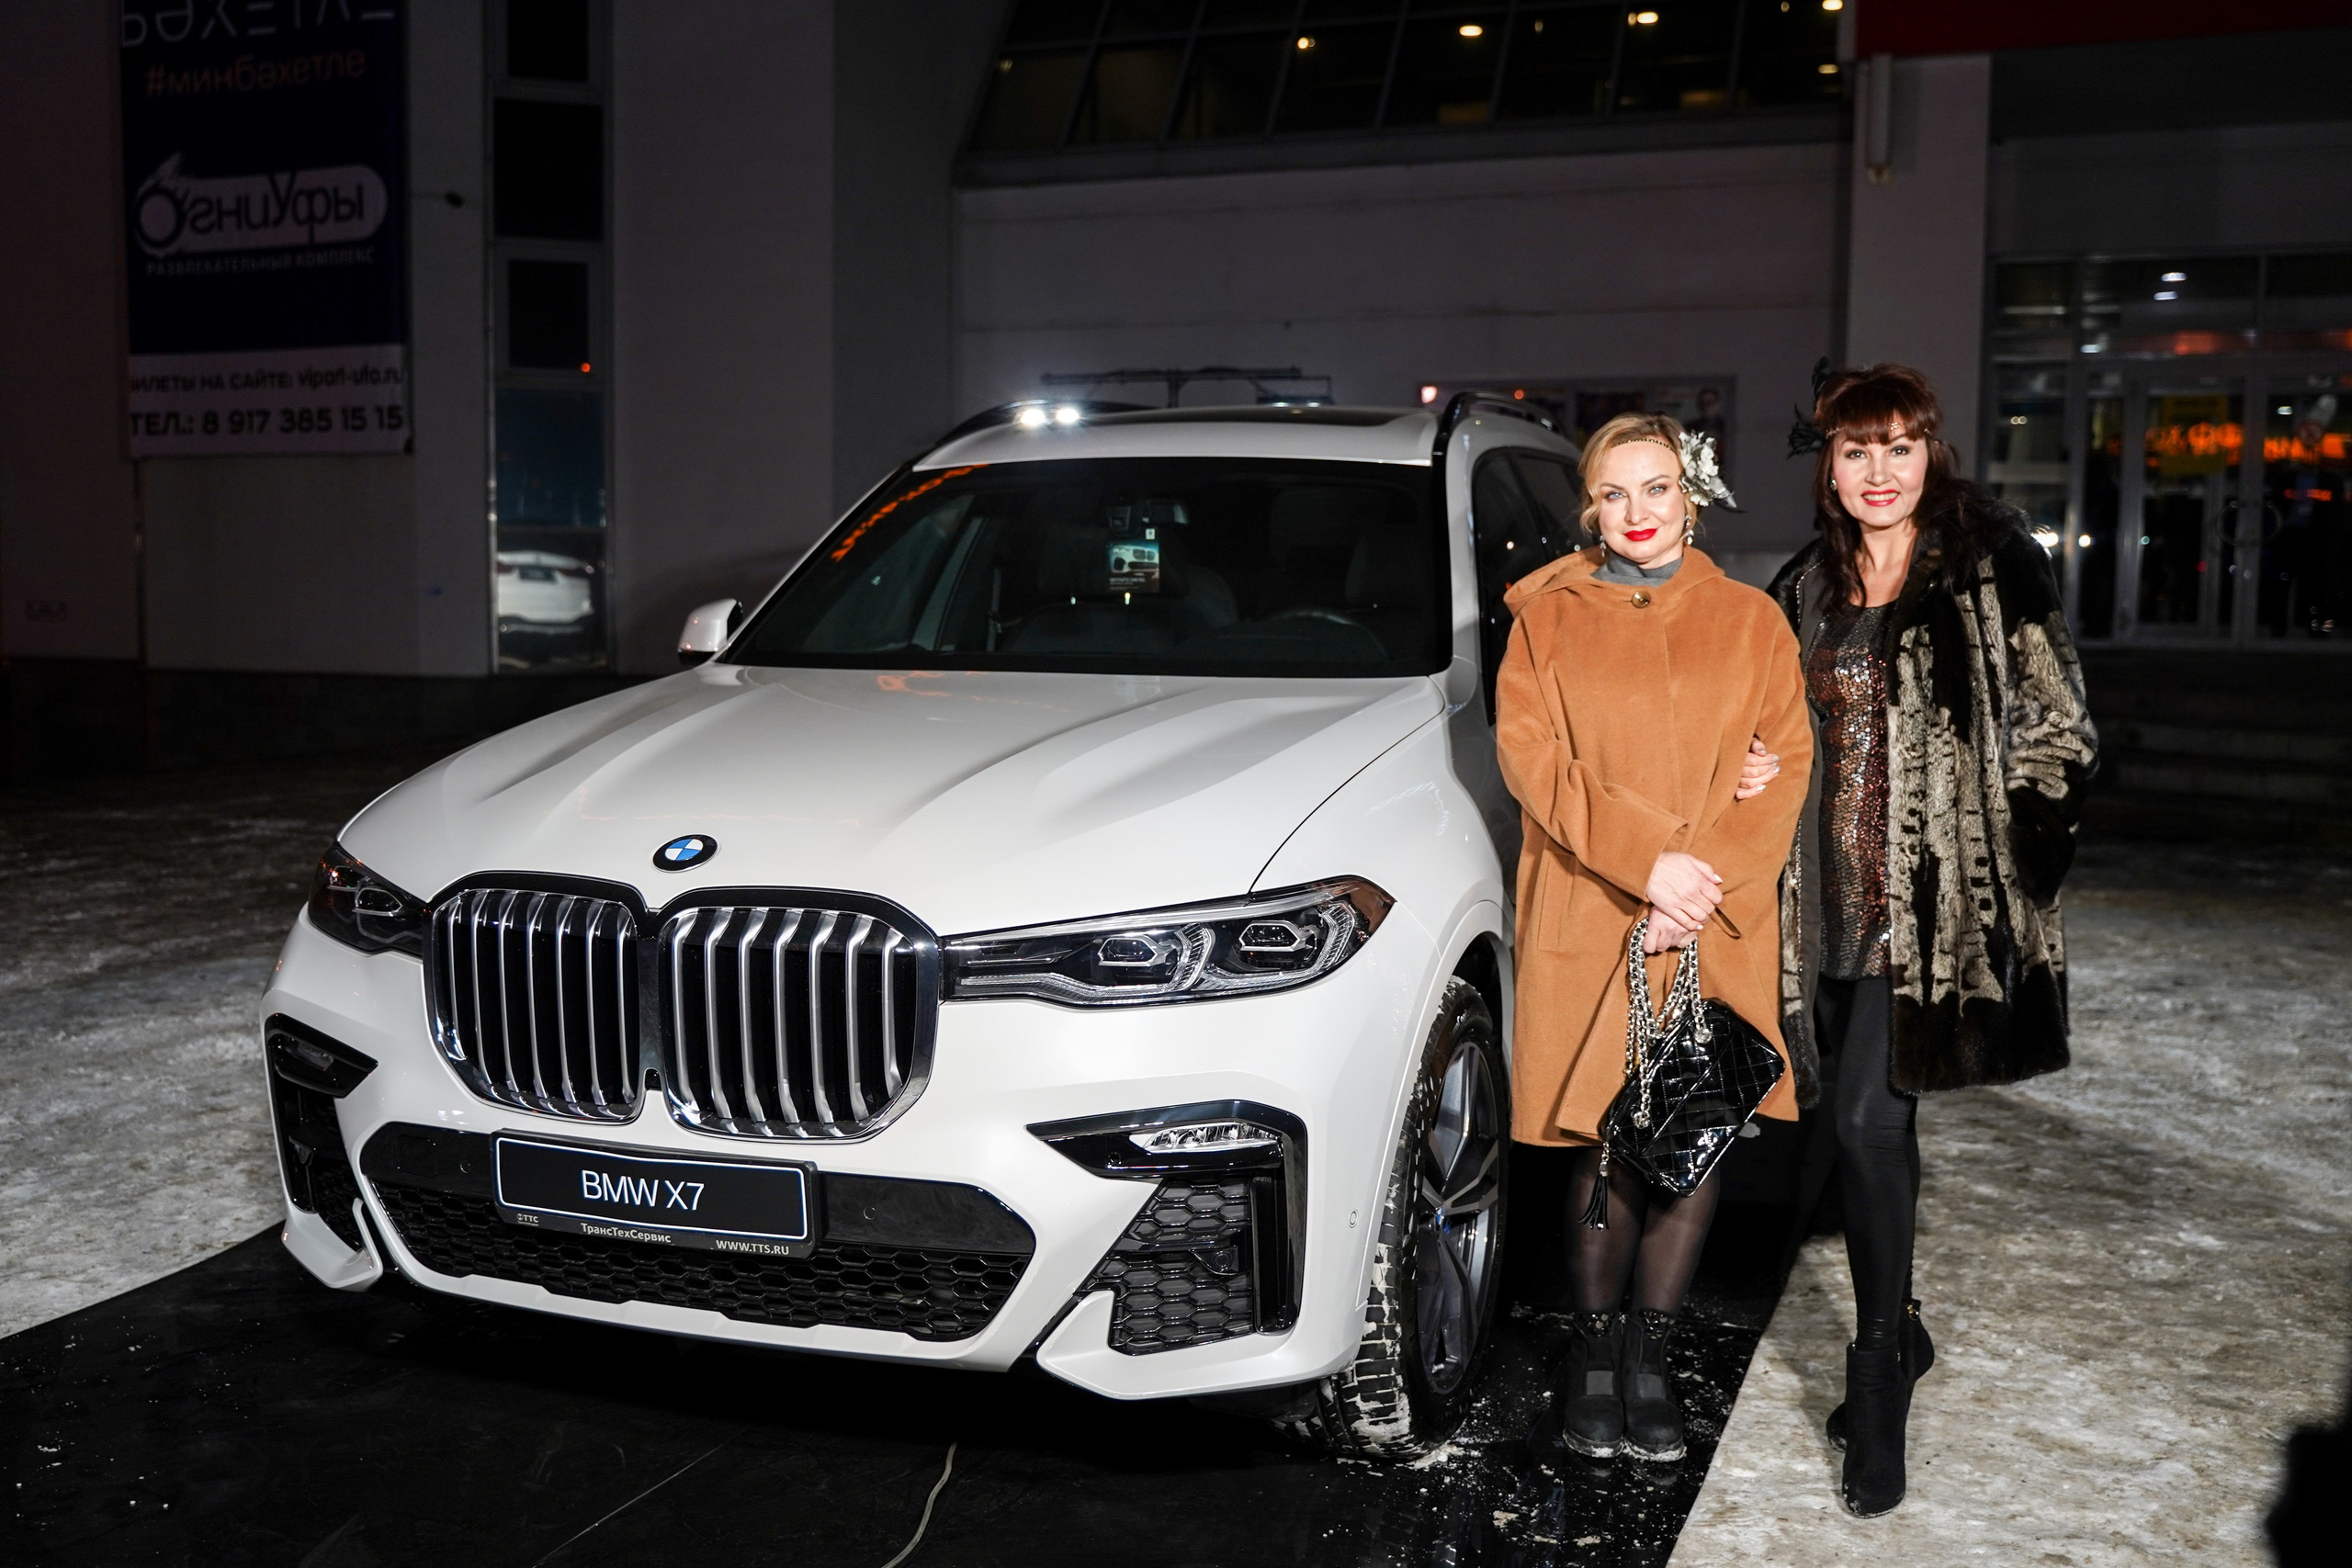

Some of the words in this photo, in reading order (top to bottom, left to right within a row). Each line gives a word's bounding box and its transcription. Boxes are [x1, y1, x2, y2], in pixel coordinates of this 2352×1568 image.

[200, 371, 226, 391] НА
[200, 410, 221, 435] 8
[227, 408, 272, 434] 917
[278, 407, 334, 434] 385
[340, 405, 368, 432] 15
[375, 403, 405, 431] 15
[581, 1168, 660, 1208] BMW
[664, 1180, 705, 1212] X7
[581, 1223, 673, 1244] ТрансТехСервис
[716, 1239, 790, 1257] WWW.TTS.RU
